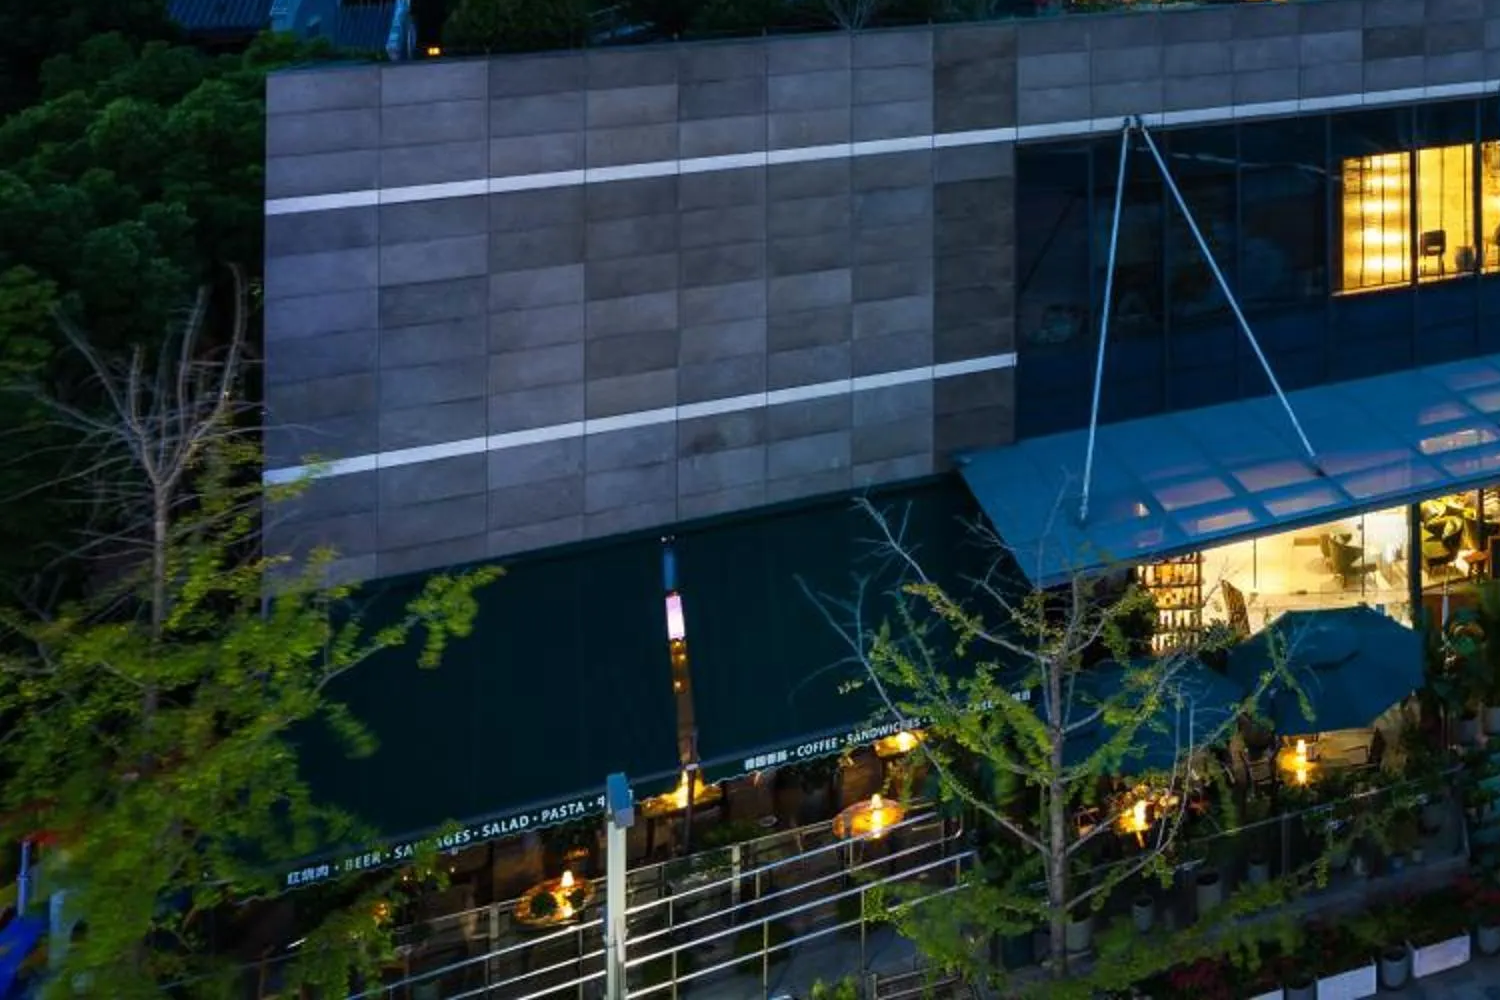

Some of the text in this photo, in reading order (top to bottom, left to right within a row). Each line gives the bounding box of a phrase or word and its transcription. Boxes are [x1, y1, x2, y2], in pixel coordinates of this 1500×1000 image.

[797, 737, 838, 757] COFFEE
[482, 815, 529, 837] SALAD
[541, 801, 585, 822] PASTA
